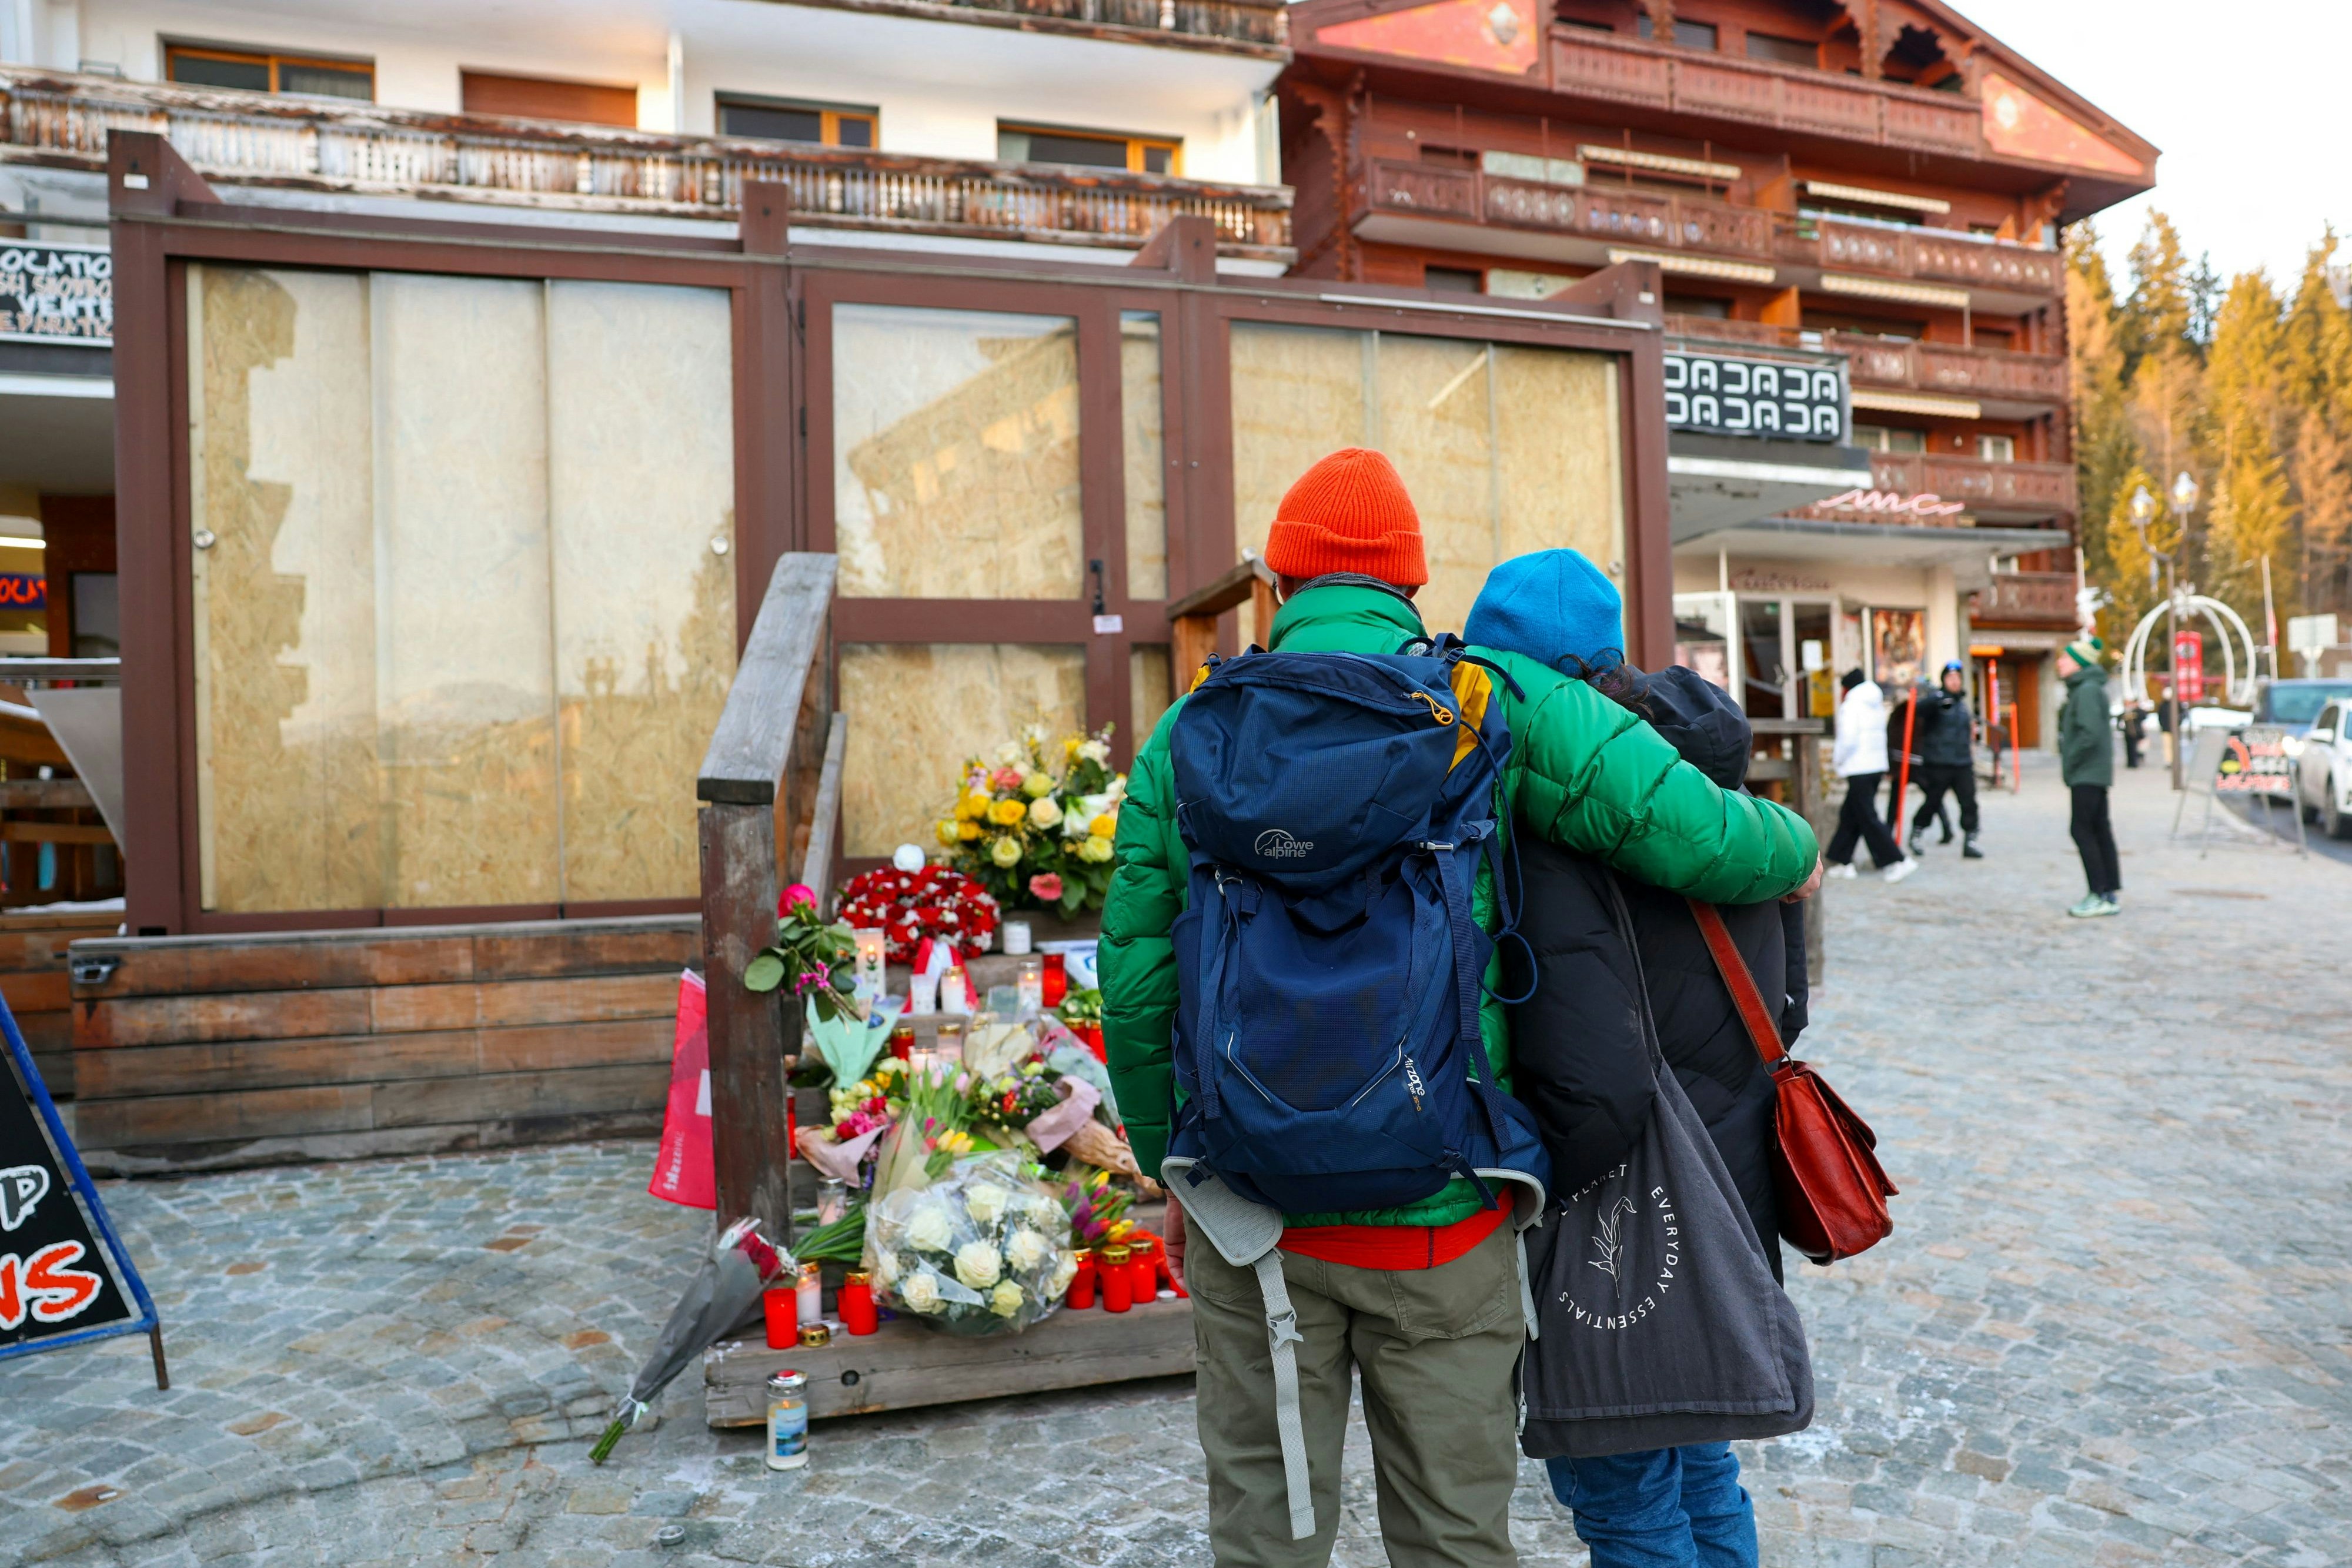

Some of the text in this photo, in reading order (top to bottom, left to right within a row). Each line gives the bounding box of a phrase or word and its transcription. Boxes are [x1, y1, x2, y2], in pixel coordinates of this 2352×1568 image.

[1276, 838, 1314, 850] Lowe
[1264, 847, 1306, 859] alpine
[1408, 1082, 1416, 1095] Trek
[1651, 1186, 1679, 1294] EVERYDAY
[1559, 1291, 1656, 1330] ESSENTIALS
